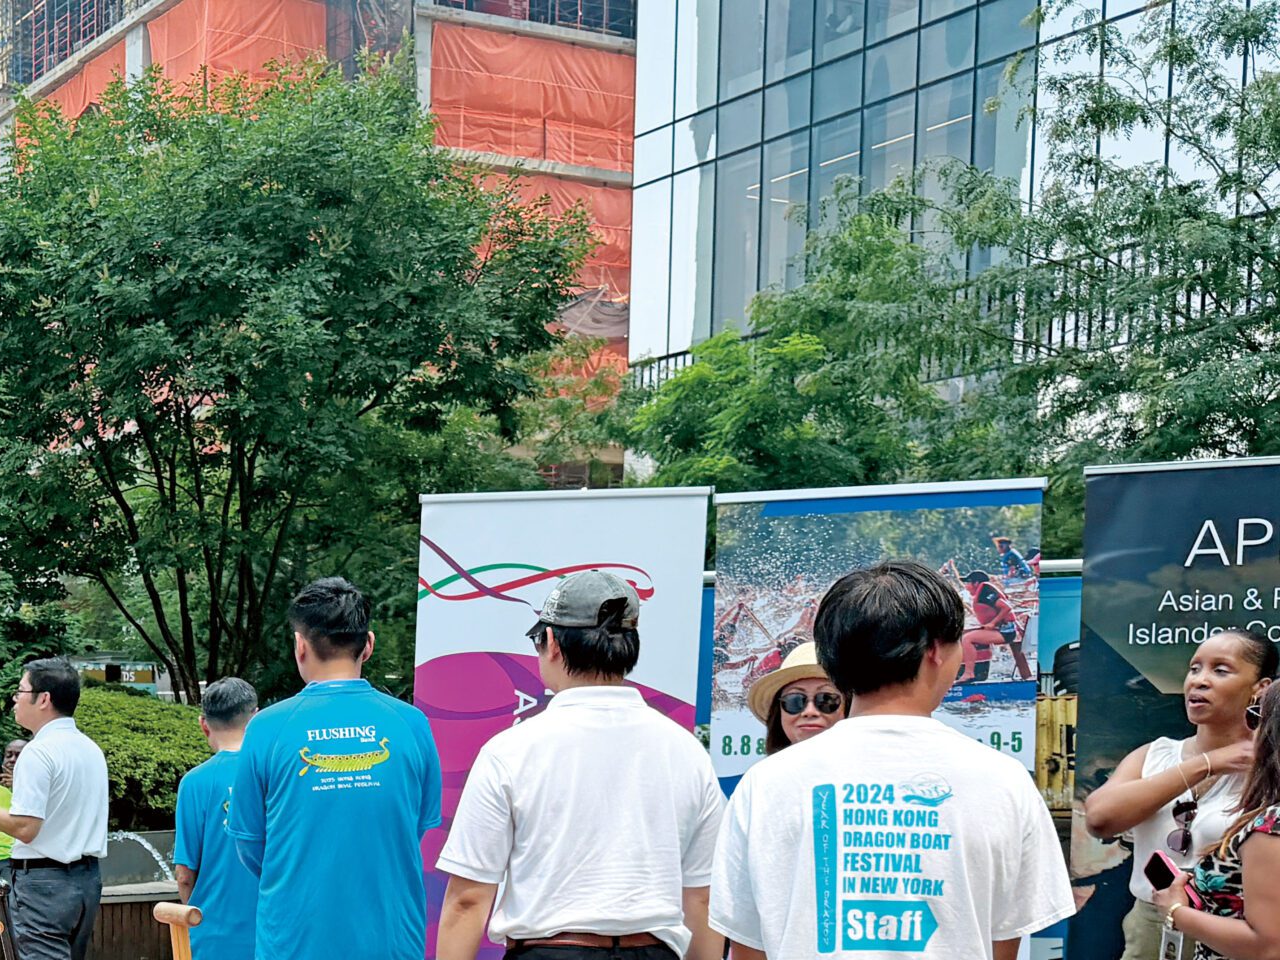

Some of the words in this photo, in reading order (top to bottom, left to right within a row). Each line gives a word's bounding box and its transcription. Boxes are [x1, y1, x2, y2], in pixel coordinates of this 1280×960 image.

[1157, 589, 1233, 612] Asian
[1242, 588, 1263, 611] &
[1128, 621, 1237, 645] Island
[307, 725, 376, 741] FLUSHING
[721, 734, 751, 756] 8.8
[842, 783, 895, 804] 2024
[843, 808, 888, 826] HONG
[893, 809, 939, 827] KONG
[843, 831, 906, 848] DRAGON
[910, 833, 952, 850] BOAT
[843, 853, 923, 873] FESTIVAL
[842, 876, 856, 894] IN
[860, 877, 898, 894] NEW
[902, 878, 945, 896] YORK
[846, 908, 923, 941] Staff
